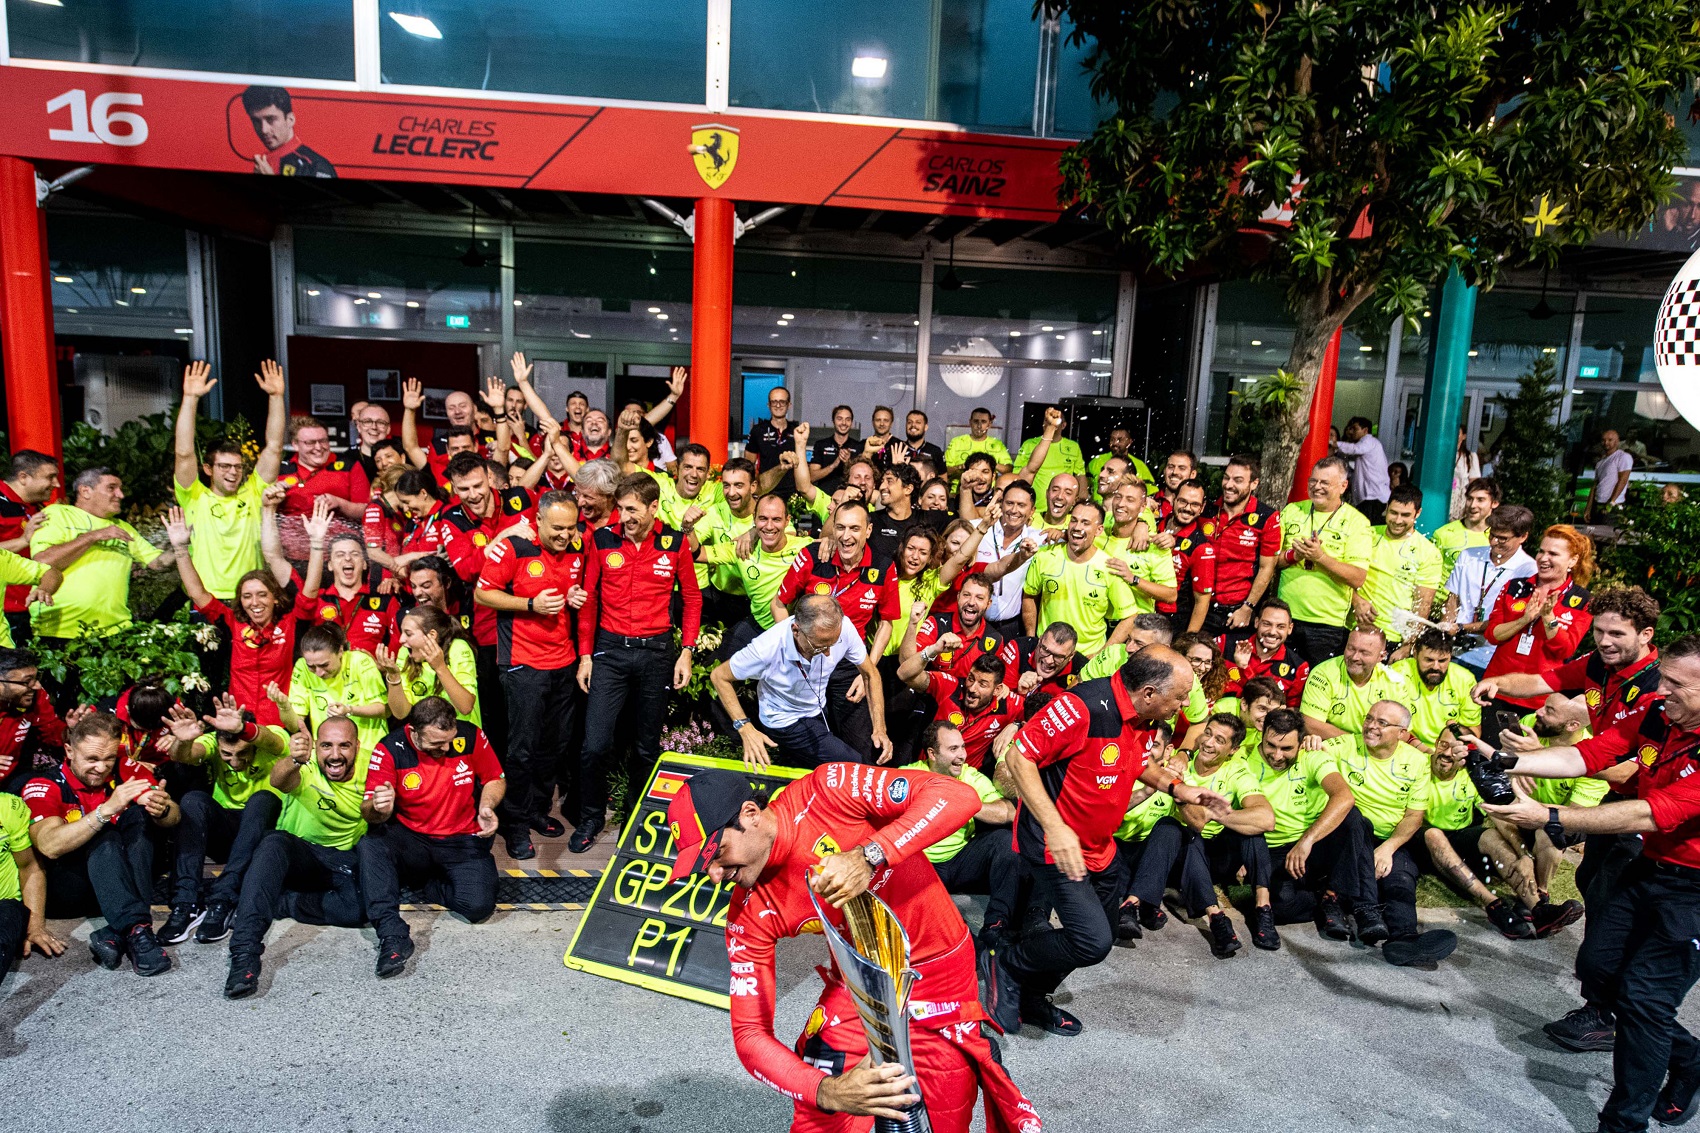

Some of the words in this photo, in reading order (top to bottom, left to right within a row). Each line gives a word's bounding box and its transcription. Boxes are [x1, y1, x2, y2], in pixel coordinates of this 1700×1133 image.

[46, 88, 149, 147] 16
[398, 115, 497, 137] CHARLES
[372, 133, 499, 161] LECLERC
[928, 155, 1006, 175] CARLOS
[923, 172, 1007, 197] SAINZ
[1053, 699, 1076, 727] MAHLE
[1040, 716, 1056, 738] ZCG
[826, 763, 839, 788] aws
[1096, 774, 1119, 785] VGW
[925, 797, 949, 821] MILLE
[893, 817, 930, 849] RICHARD
[627, 917, 693, 977] P1
